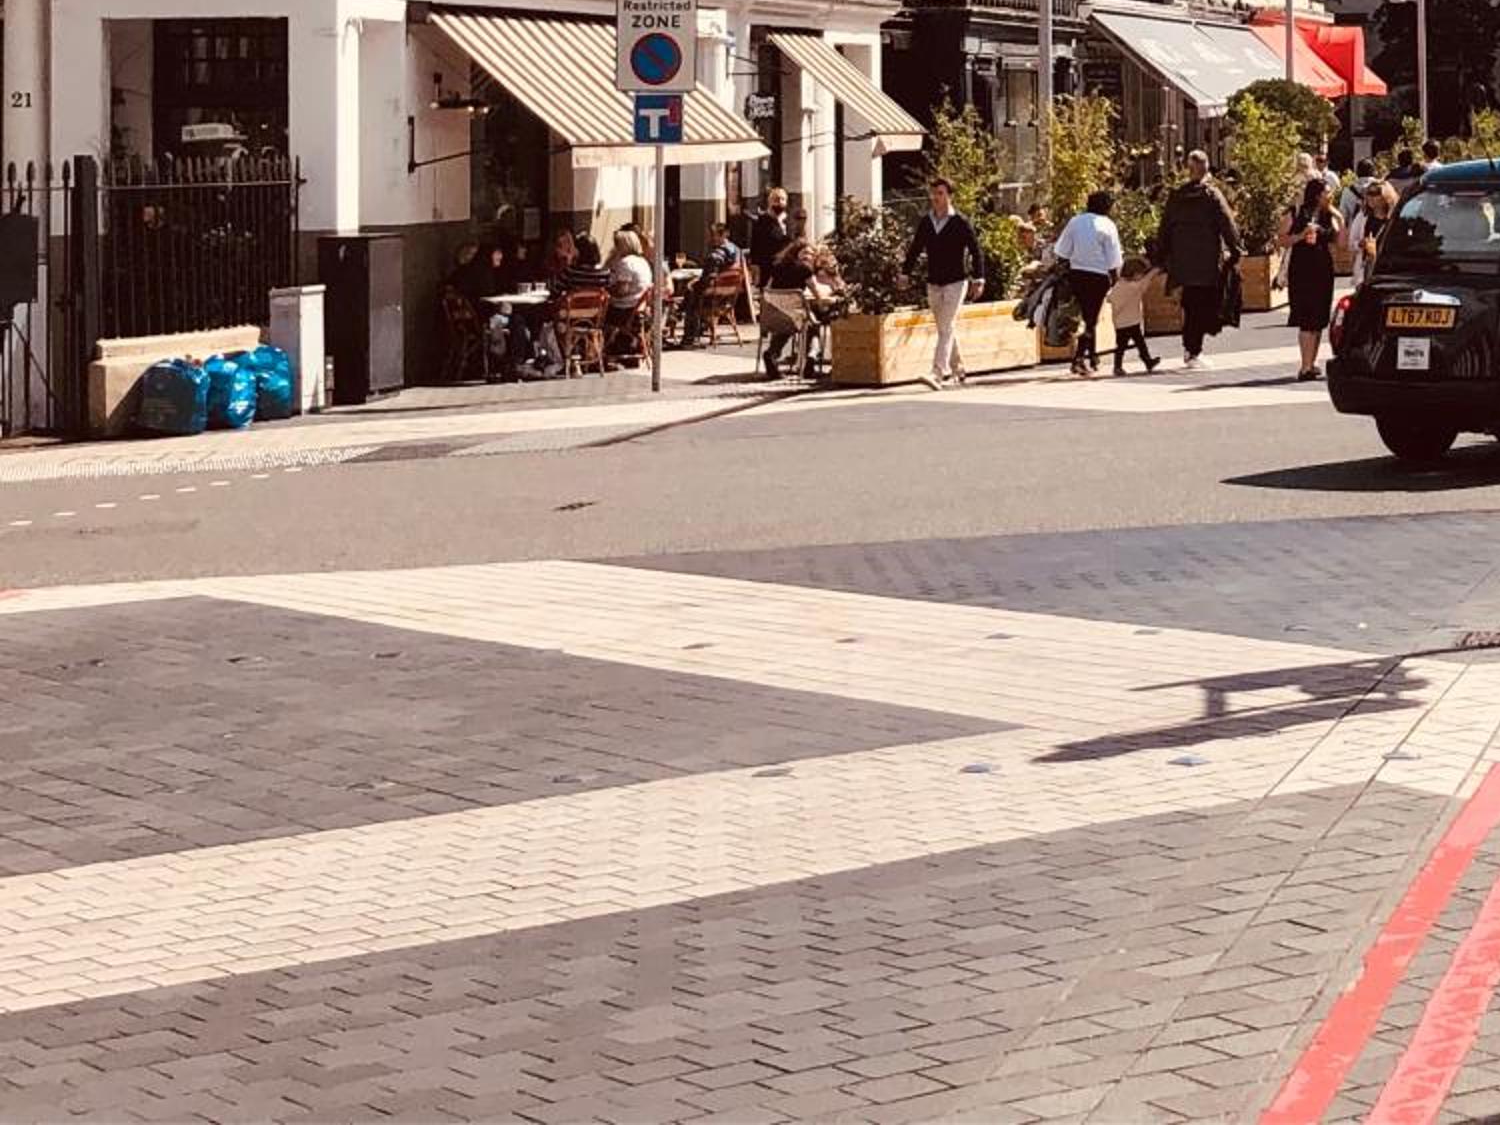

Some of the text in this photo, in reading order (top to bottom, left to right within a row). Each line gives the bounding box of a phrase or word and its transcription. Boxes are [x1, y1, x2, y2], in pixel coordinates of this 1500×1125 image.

[624, 0, 691, 12] Restricted
[631, 15, 681, 28] ZONE
[11, 91, 32, 108] 21
